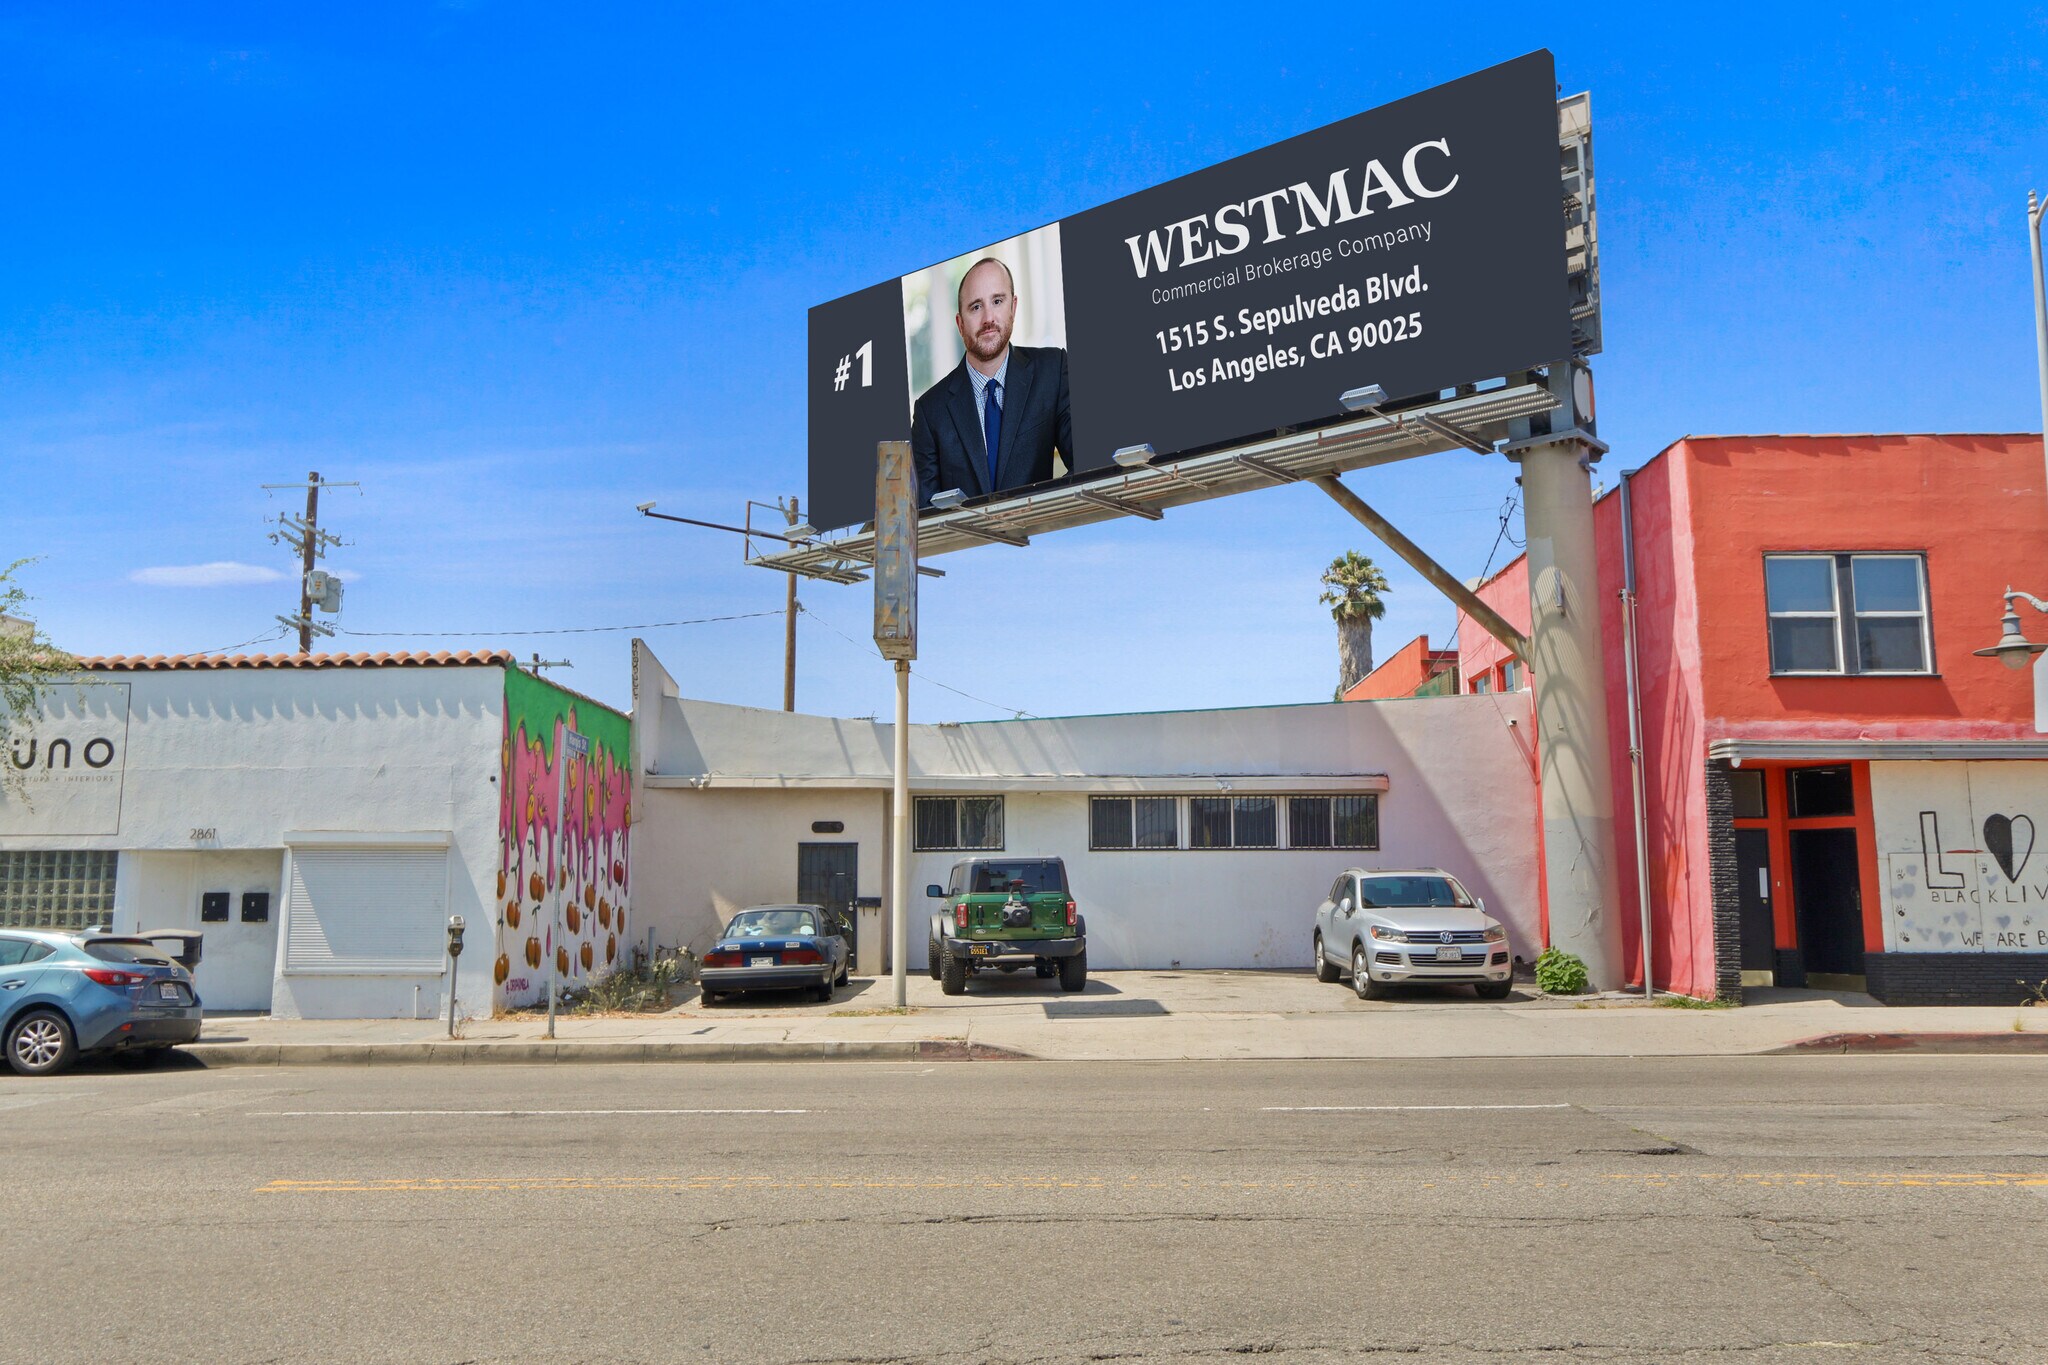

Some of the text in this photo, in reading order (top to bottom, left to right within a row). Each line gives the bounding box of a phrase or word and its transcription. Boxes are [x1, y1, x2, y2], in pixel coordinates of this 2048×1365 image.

[1125, 138, 1460, 279] WESTMAC
[1151, 221, 1432, 305] Commercial Brokerage Company
[1156, 264, 1429, 355] 1515 S. Sepulveda Blvd.
[834, 339, 873, 392] #1
[1169, 311, 1423, 392] Los Angeles, CA 90025
[64, 775, 114, 783] INTERIORS
[189, 827, 217, 840] 2861
[1960, 931, 1983, 946] WE
[1996, 931, 2028, 948] ARE
